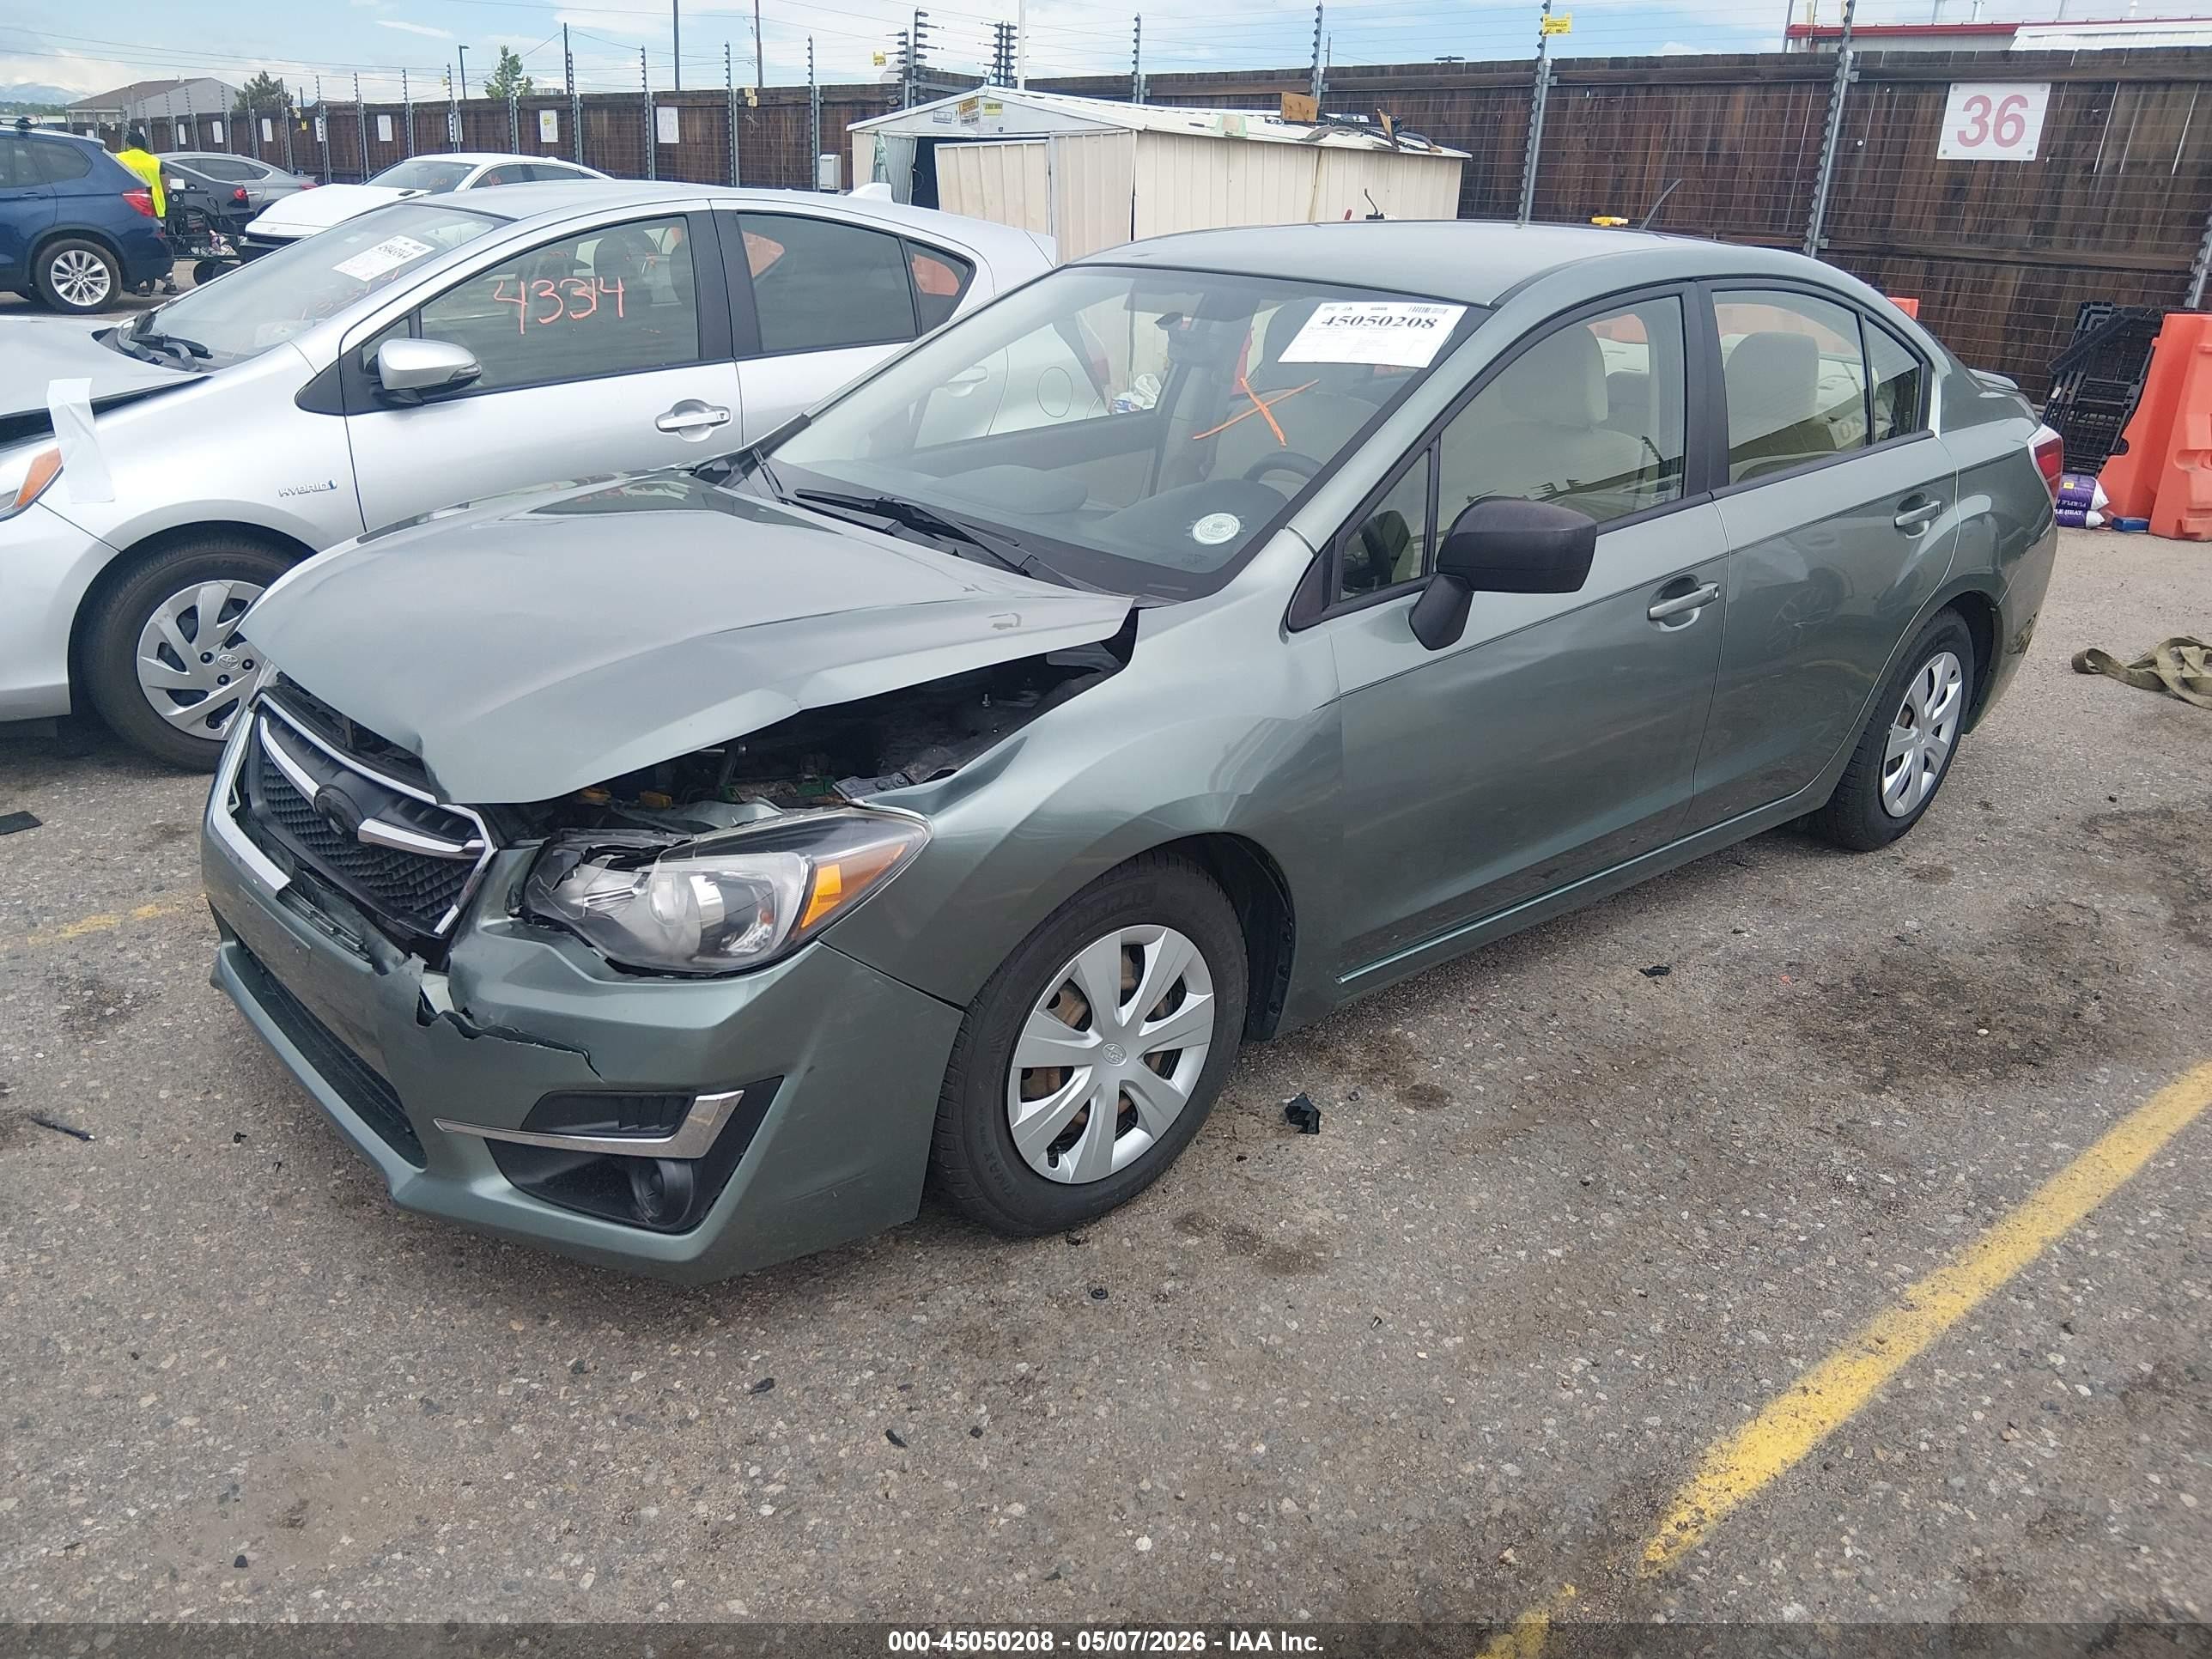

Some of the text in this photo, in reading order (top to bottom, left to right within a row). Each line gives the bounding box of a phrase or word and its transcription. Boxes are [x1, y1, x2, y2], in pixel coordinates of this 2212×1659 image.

[1957, 94, 2028, 148] 36
[1321, 314, 1438, 330] 45050208
[277, 482, 328, 497] HYBRID
